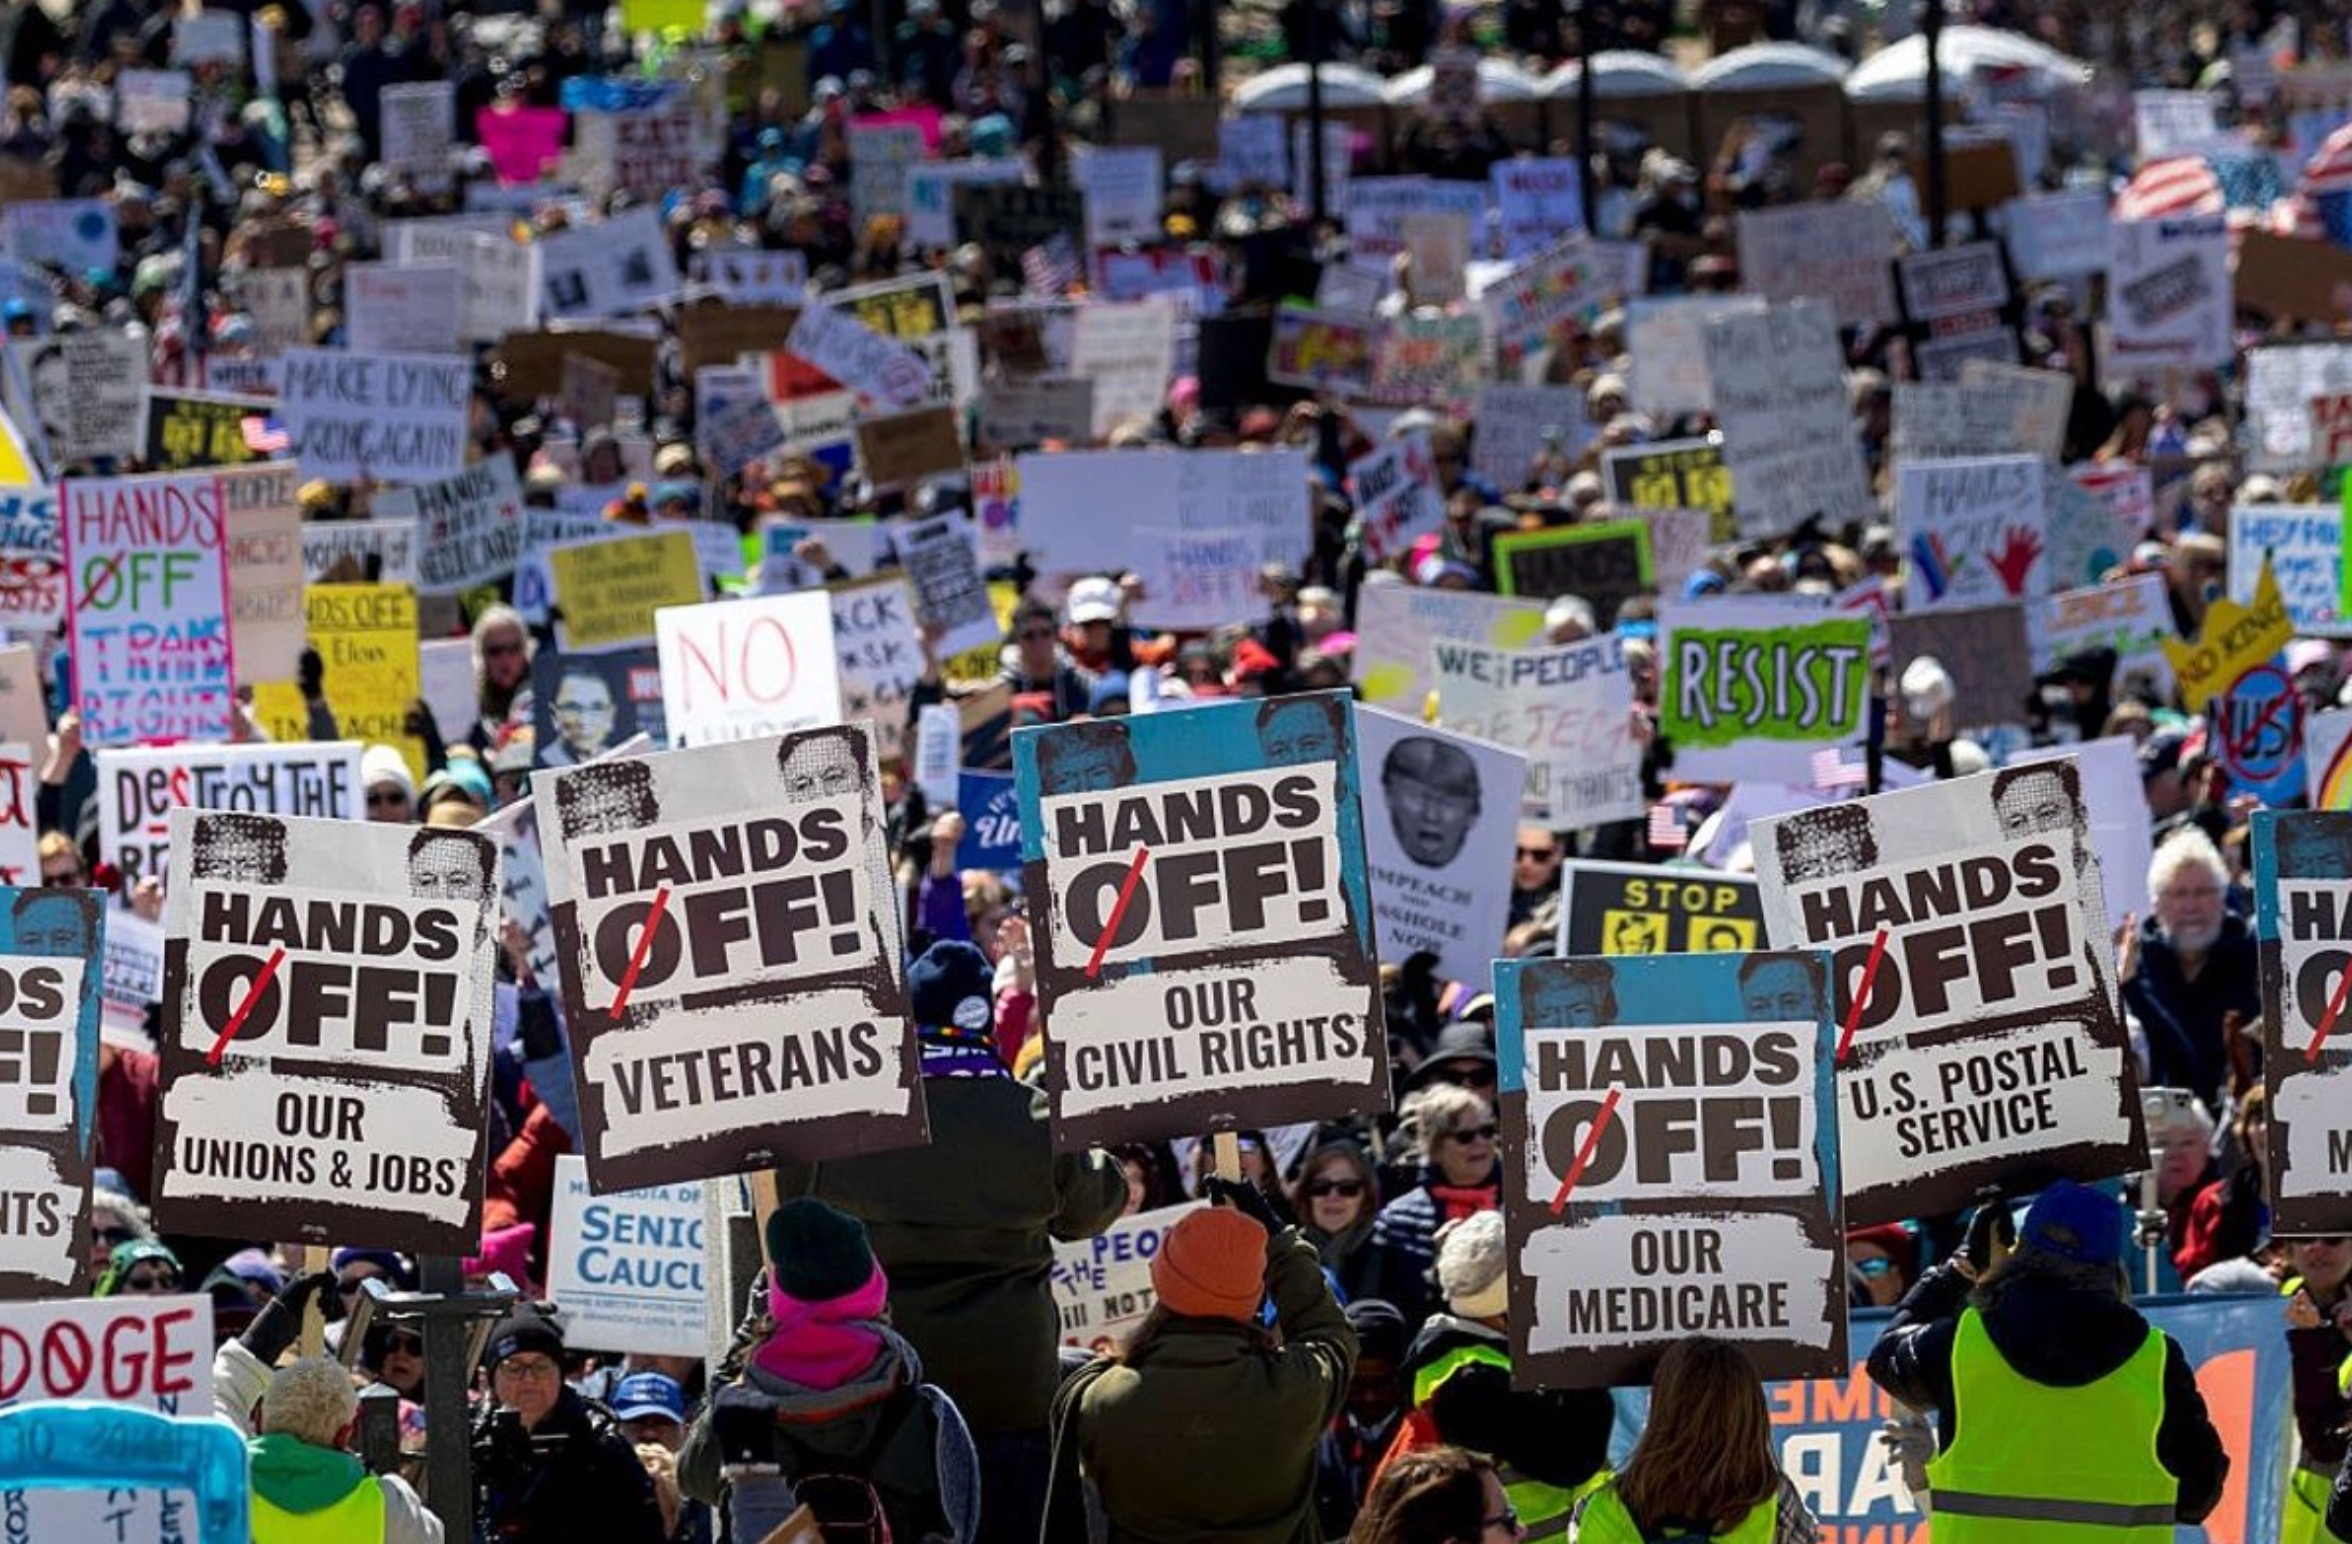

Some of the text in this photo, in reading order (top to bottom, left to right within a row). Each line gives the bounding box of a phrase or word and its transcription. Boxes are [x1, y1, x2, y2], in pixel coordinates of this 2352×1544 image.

[285, 358, 374, 406] MAKE
[303, 415, 374, 465] RONG
[79, 484, 223, 548] HANDS
[80, 551, 202, 611] OFF
[354, 594, 403, 628] OFF
[333, 640, 387, 668] Elon
[677, 615, 798, 713] NO
[1437, 645, 1491, 681] WE
[1680, 637, 1861, 730] RESIST
[1055, 775, 1321, 858] HANDS
[581, 807, 849, 900] HANDS
[1064, 835, 1332, 951] OFF!
[1623, 879, 1739, 913] STOP
[1800, 843, 2063, 943] HANDS
[200, 890, 461, 960] HANDS
[594, 869, 863, 990] OFF!
[1834, 901, 2079, 1032] OFF!
[199, 952, 458, 1056] OFF!
[1166, 976, 1258, 1031] OUR
[611, 1020, 884, 1116] VETERANS
[1075, 1013, 1360, 1094] CIVIL RIGHTS
[1537, 1031, 1802, 1092] HANDS
[1850, 1035, 2089, 1120] U.S. POSTAL
[276, 1091, 366, 1142] OUR
[1542, 1096, 1803, 1188] OFF!
[1896, 1088, 2059, 1159] SERVICE
[183, 1136, 457, 1197] UNIONS & JOBS
[1092, 1226, 1173, 1265] PEO
[1630, 1229, 1724, 1277] OUR
[1059, 1258, 1107, 1297] THE
[1104, 1288, 1155, 1320] NOT
[1567, 1281, 1791, 1335] MEDICARE
